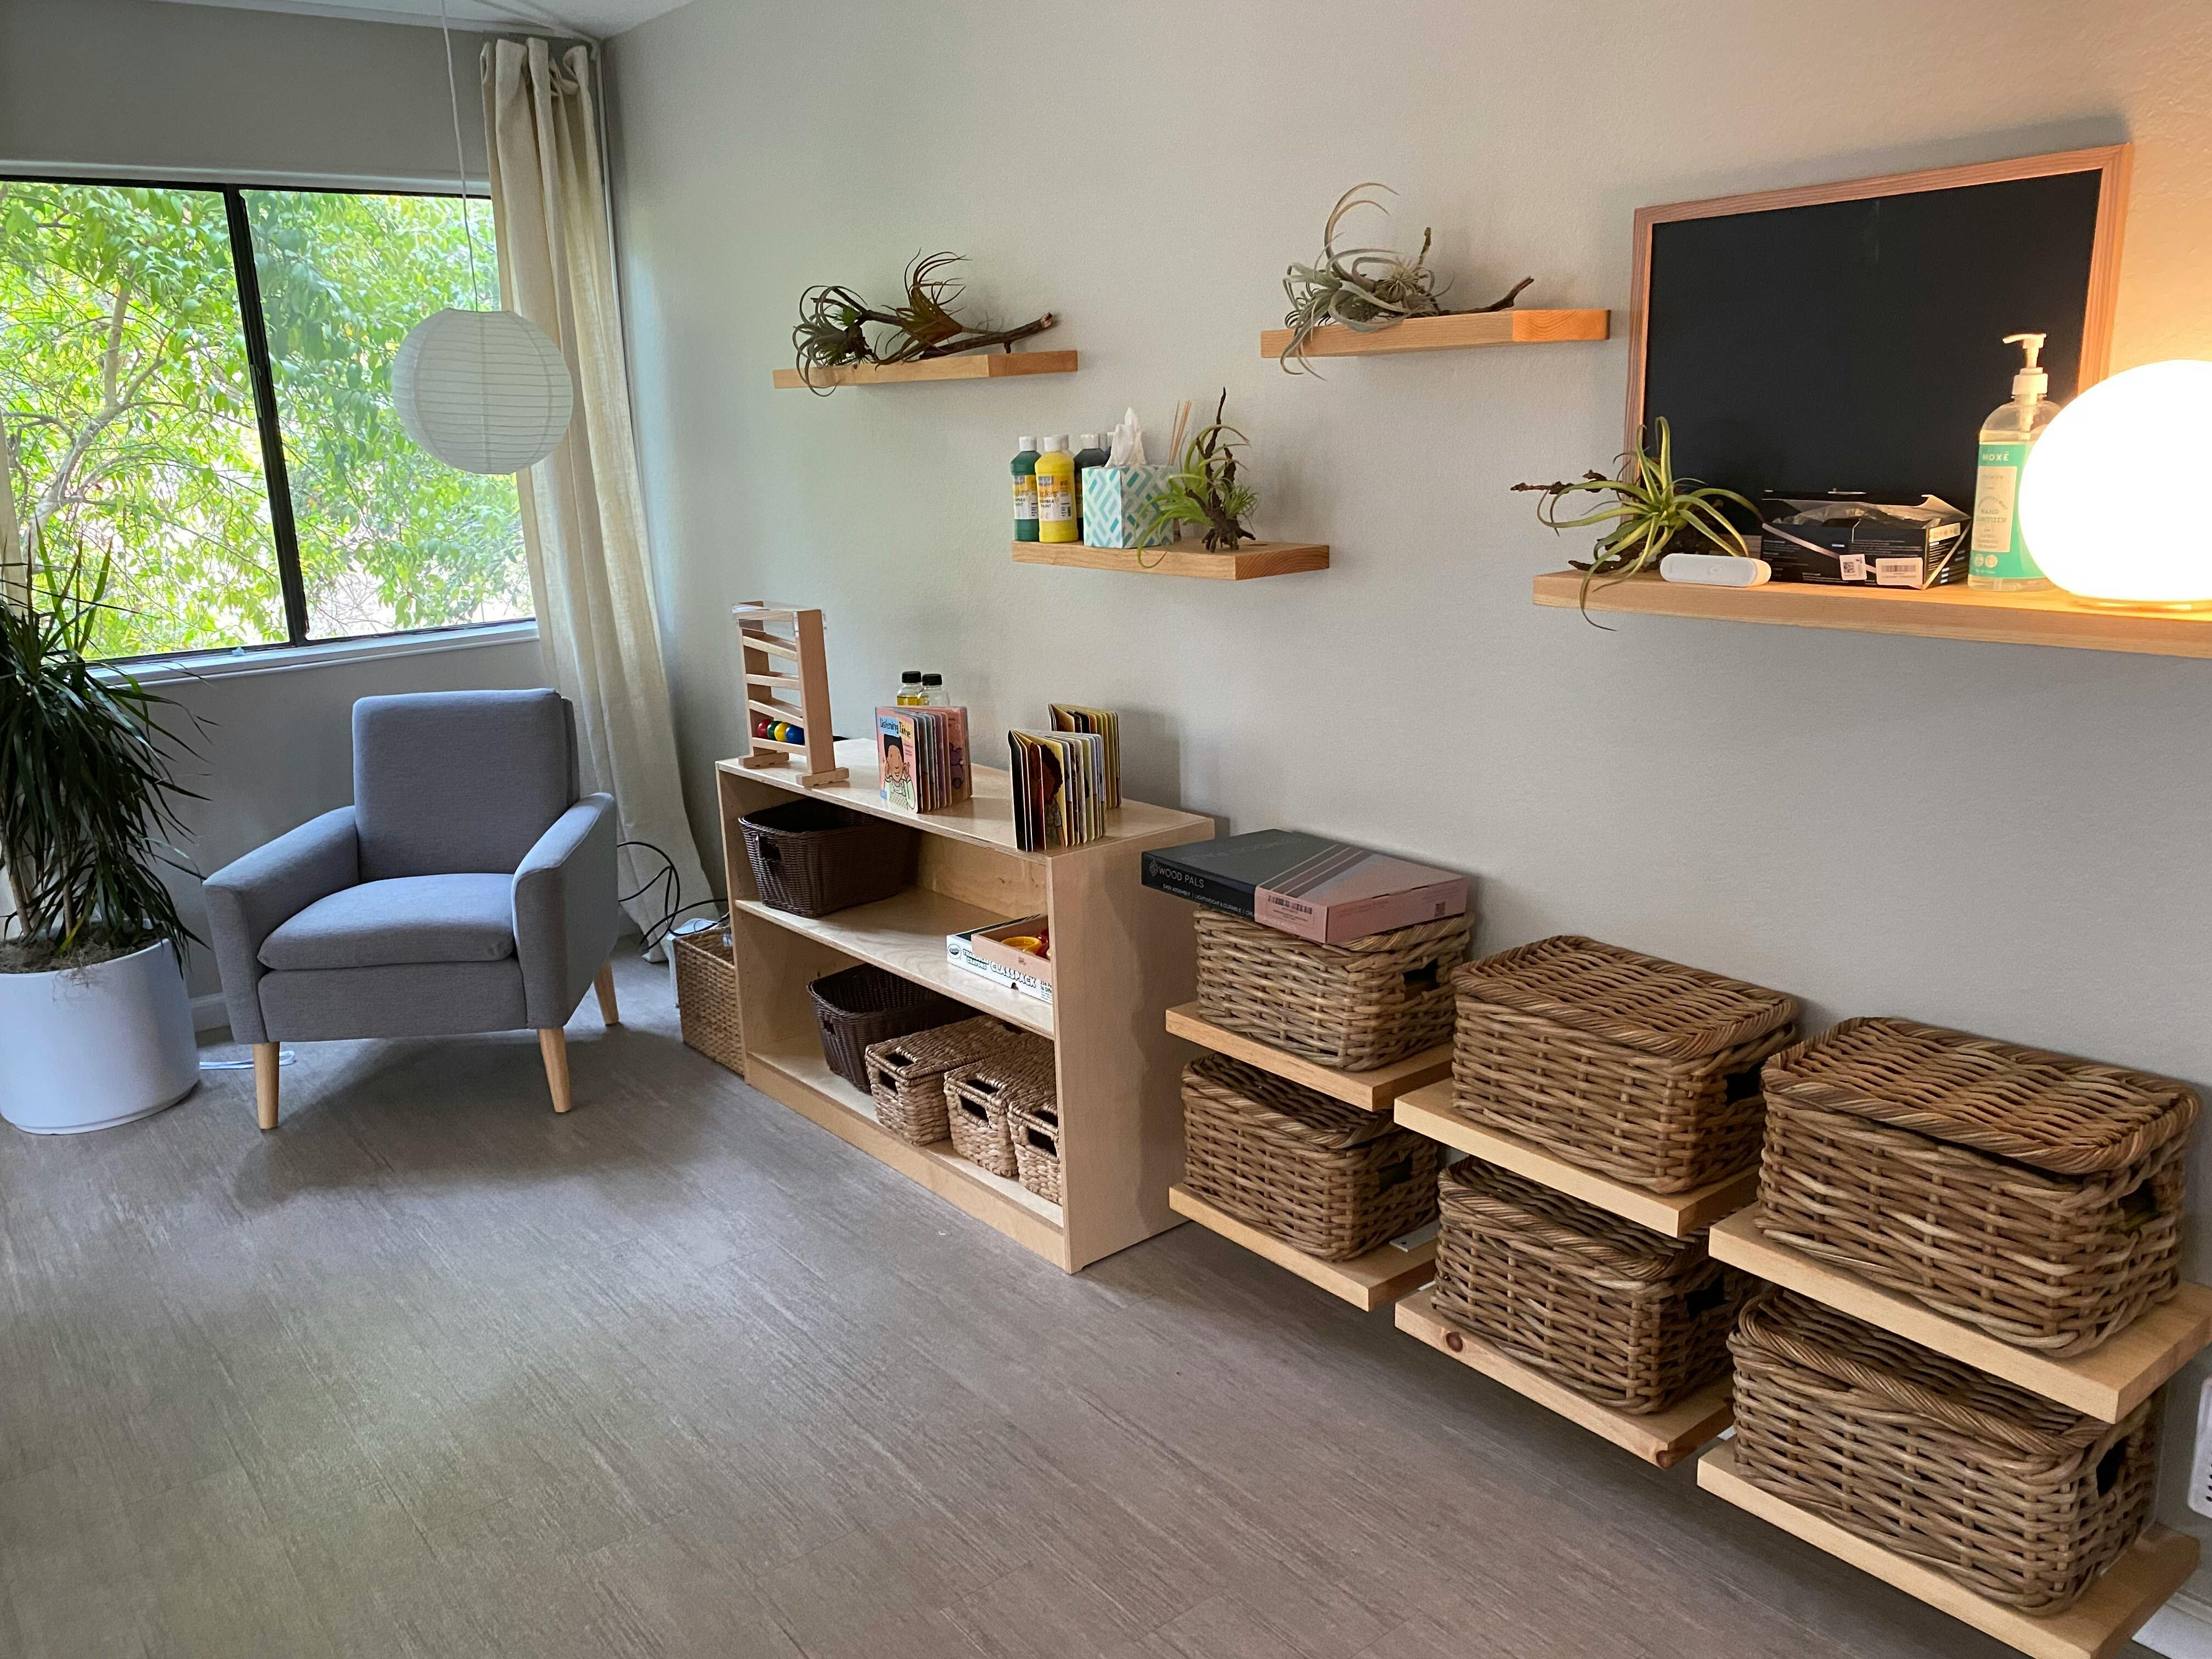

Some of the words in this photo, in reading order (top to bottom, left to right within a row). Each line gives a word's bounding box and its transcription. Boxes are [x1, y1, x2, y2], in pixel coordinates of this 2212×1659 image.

[880, 718, 899, 734] Listening
[899, 721, 911, 738] Time
[1159, 867, 1182, 881] WOOD
[1185, 874, 1204, 888] PALS
[990, 962, 1036, 988] CLASSPACK
